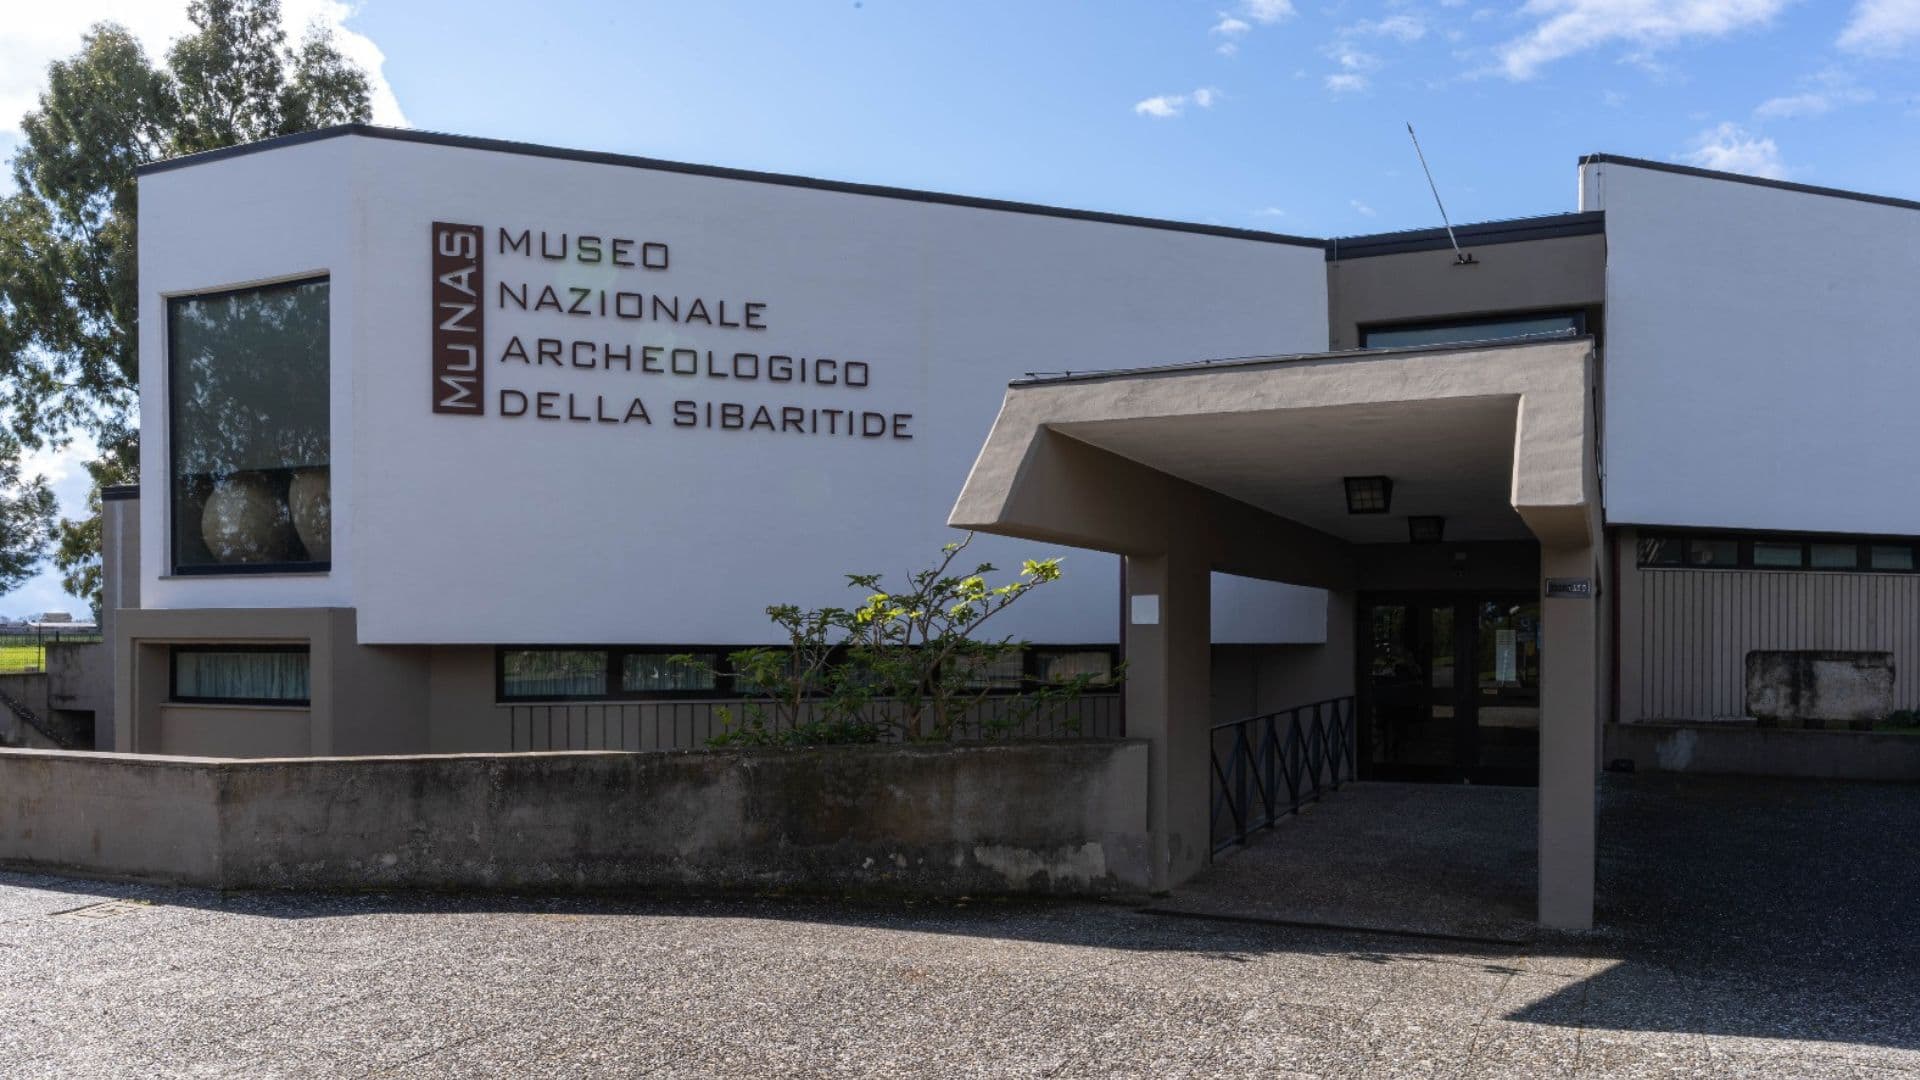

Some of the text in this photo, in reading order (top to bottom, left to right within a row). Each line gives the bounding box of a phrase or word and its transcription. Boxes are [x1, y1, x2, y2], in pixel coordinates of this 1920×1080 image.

[499, 226, 669, 271] MUSEO
[439, 230, 478, 409] MUNAS
[499, 281, 768, 330] NAZIONALE
[500, 335, 870, 388] ARCHEOLOGICO
[499, 389, 914, 440] DELLA SIBARITIDE
